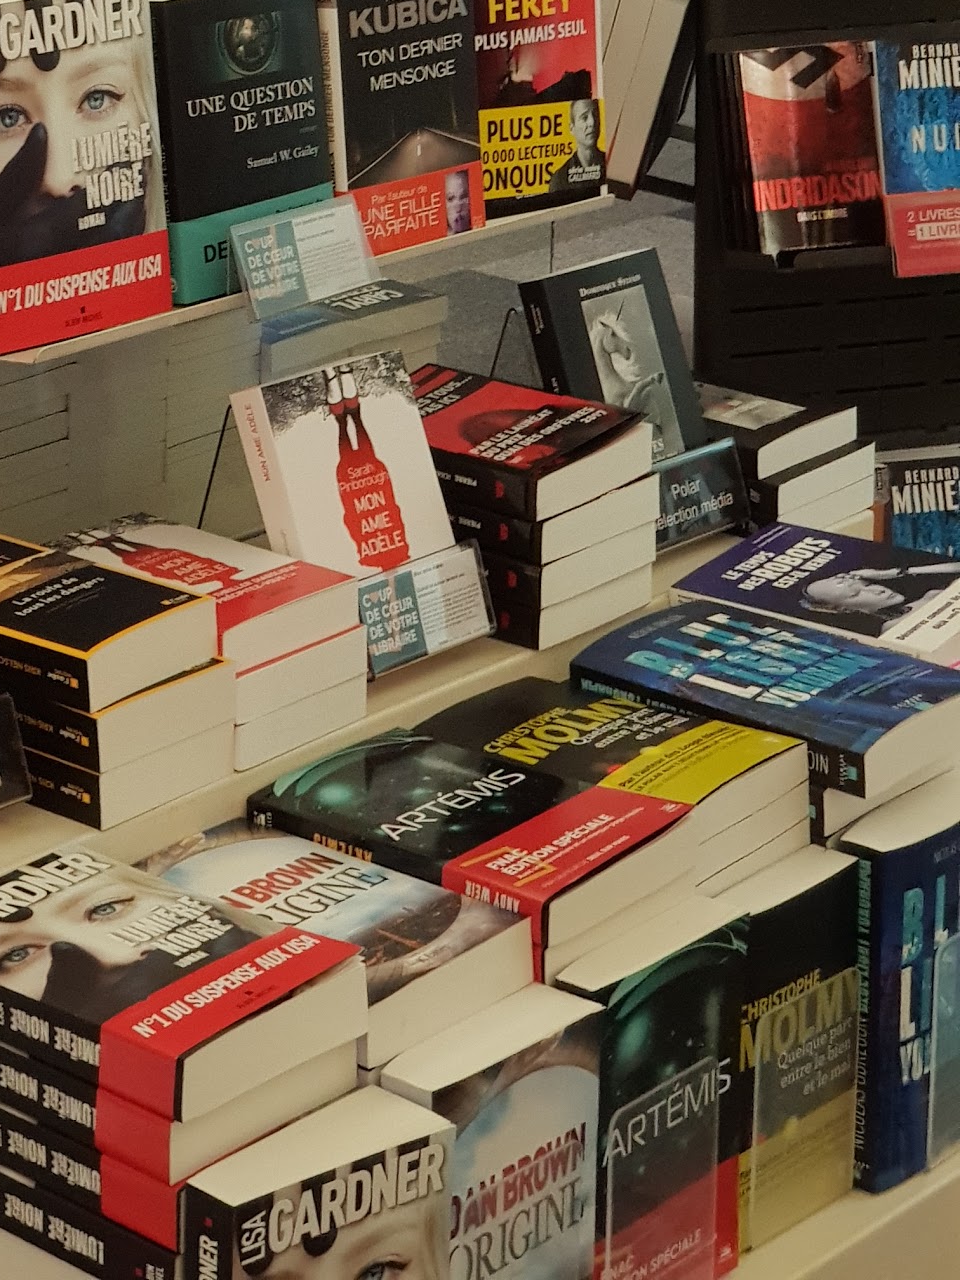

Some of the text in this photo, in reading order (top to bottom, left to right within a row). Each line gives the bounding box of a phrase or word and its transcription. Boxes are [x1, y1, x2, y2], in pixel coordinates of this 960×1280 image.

[509, 18, 588, 50] JAMAIS SEUL
[357, 46, 395, 68] TON
[912, 43, 960, 59] BERNAR
[370, 58, 457, 92] MENSONGE
[187, 76, 314, 118] UNE QUESTION
[261, 99, 316, 128] TEMPS
[487, 116, 534, 144] PLUS
[246, 149, 292, 170] Samuel W.
[492, 141, 574, 163] 000 LECTEURS
[399, 192, 441, 219] FILLE
[753, 171, 882, 213] INDRIDASON
[907, 211, 915, 222] 2
[44, 253, 163, 304] SUSPENSE USA
[244, 403, 271, 482] MON AMIE ADÈLE
[469, 437, 493, 455] PAR
[339, 470, 390, 494] Pinborough
[348, 463, 373, 480] Sarah
[671, 478, 702, 500] Polar
[700, 491, 735, 516] média
[891, 481, 960, 515] MINIE
[360, 511, 393, 536] AMIE
[359, 530, 406, 560] ADÈLE
[759, 535, 833, 583] ROBOTS
[155, 557, 191, 572] MON
[174, 560, 208, 577] AMIE
[11, 583, 60, 608] La route
[14, 601, 40, 619] tous
[366, 606, 384, 623] DE
[387, 610, 419, 635] VOTRE
[483, 706, 571, 754] CHRISTOPHE
[498, 698, 647, 766] MOLMY
[379, 768, 527, 842] ARTÉMIS
[555, 813, 615, 849] SPÉCIALE
[235, 851, 346, 904] BROWN
[465, 879, 521, 913] ANDY WEIR
[108, 895, 214, 947] LUMIÈRE
[152, 918, 236, 961] NOIRE
[131, 933, 321, 1040] N°1 DU SUSPENSE AUX USA
[740, 969, 859, 1072] MOLMY
[777, 1034, 828, 1070] Quelque
[780, 1037, 851, 1089] entre bien
[803, 1070, 828, 1096] et le
[602, 1056, 732, 1168] ARTÉMIS
[449, 1122, 587, 1242] DAN BROWN
[240, 1142, 446, 1268] LISA GARDNER
[448, 1175, 586, 1280] ORIGINE
